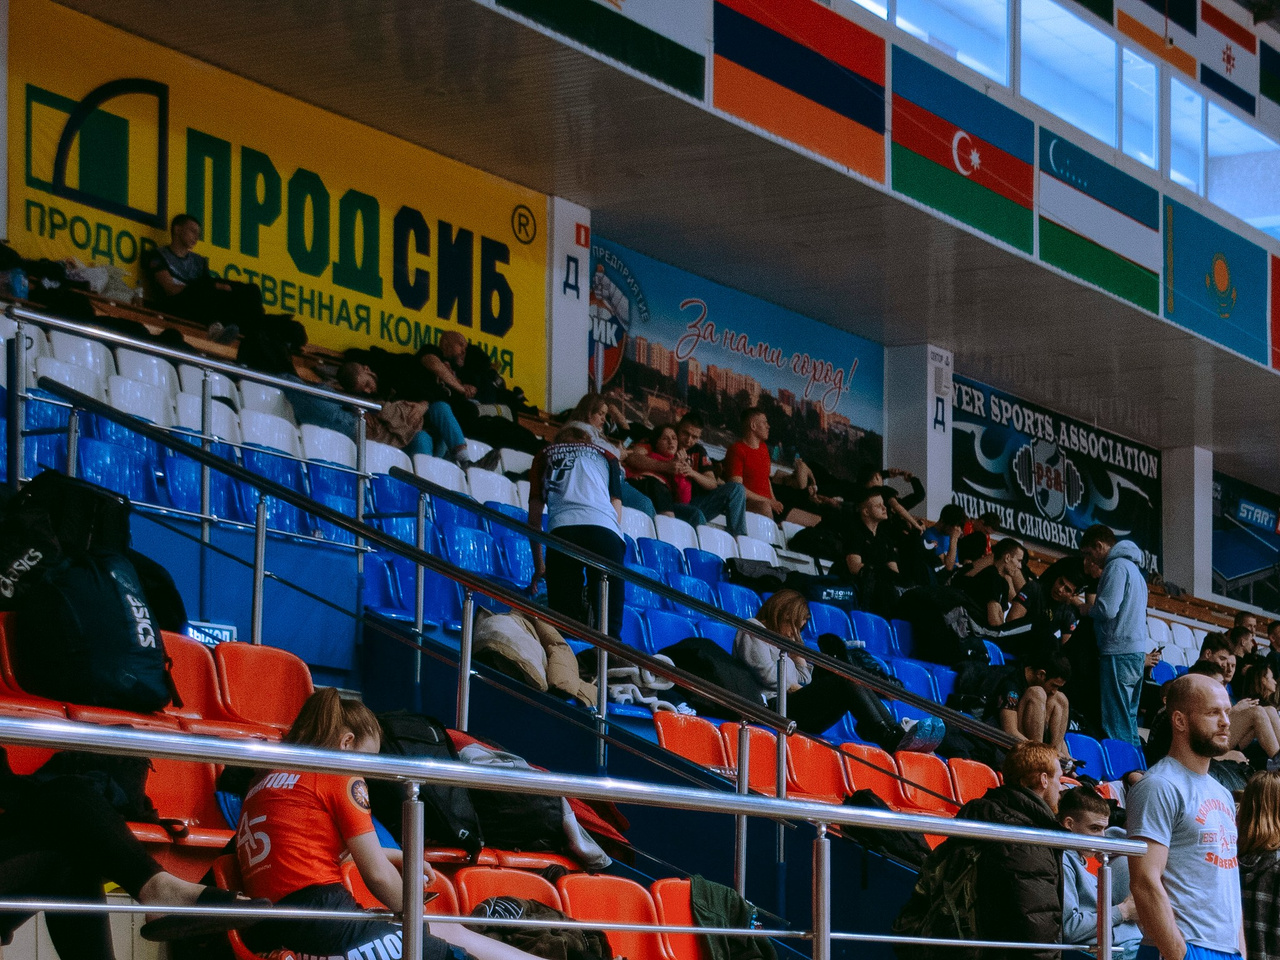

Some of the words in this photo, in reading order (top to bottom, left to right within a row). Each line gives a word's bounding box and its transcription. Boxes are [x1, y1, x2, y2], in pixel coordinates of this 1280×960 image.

[186, 127, 514, 338] ПРОДСИБ
[563, 254, 580, 299] Д
[380, 310, 514, 378] КОМПИЯ
[589, 315, 619, 348] ИК
[675, 298, 720, 361] За
[723, 328, 787, 369] нами
[790, 352, 859, 414] город!
[933, 396, 946, 433] Д
[990, 393, 1055, 443] SPORTS
[1059, 421, 1159, 480] ASSOCIATION
[1035, 461, 1064, 493] PSA
[1017, 510, 1080, 550] СИЛОВЫХ
[1195, 799, 1237, 826] KRASNOYARS
[1202, 833, 1218, 843] EST
